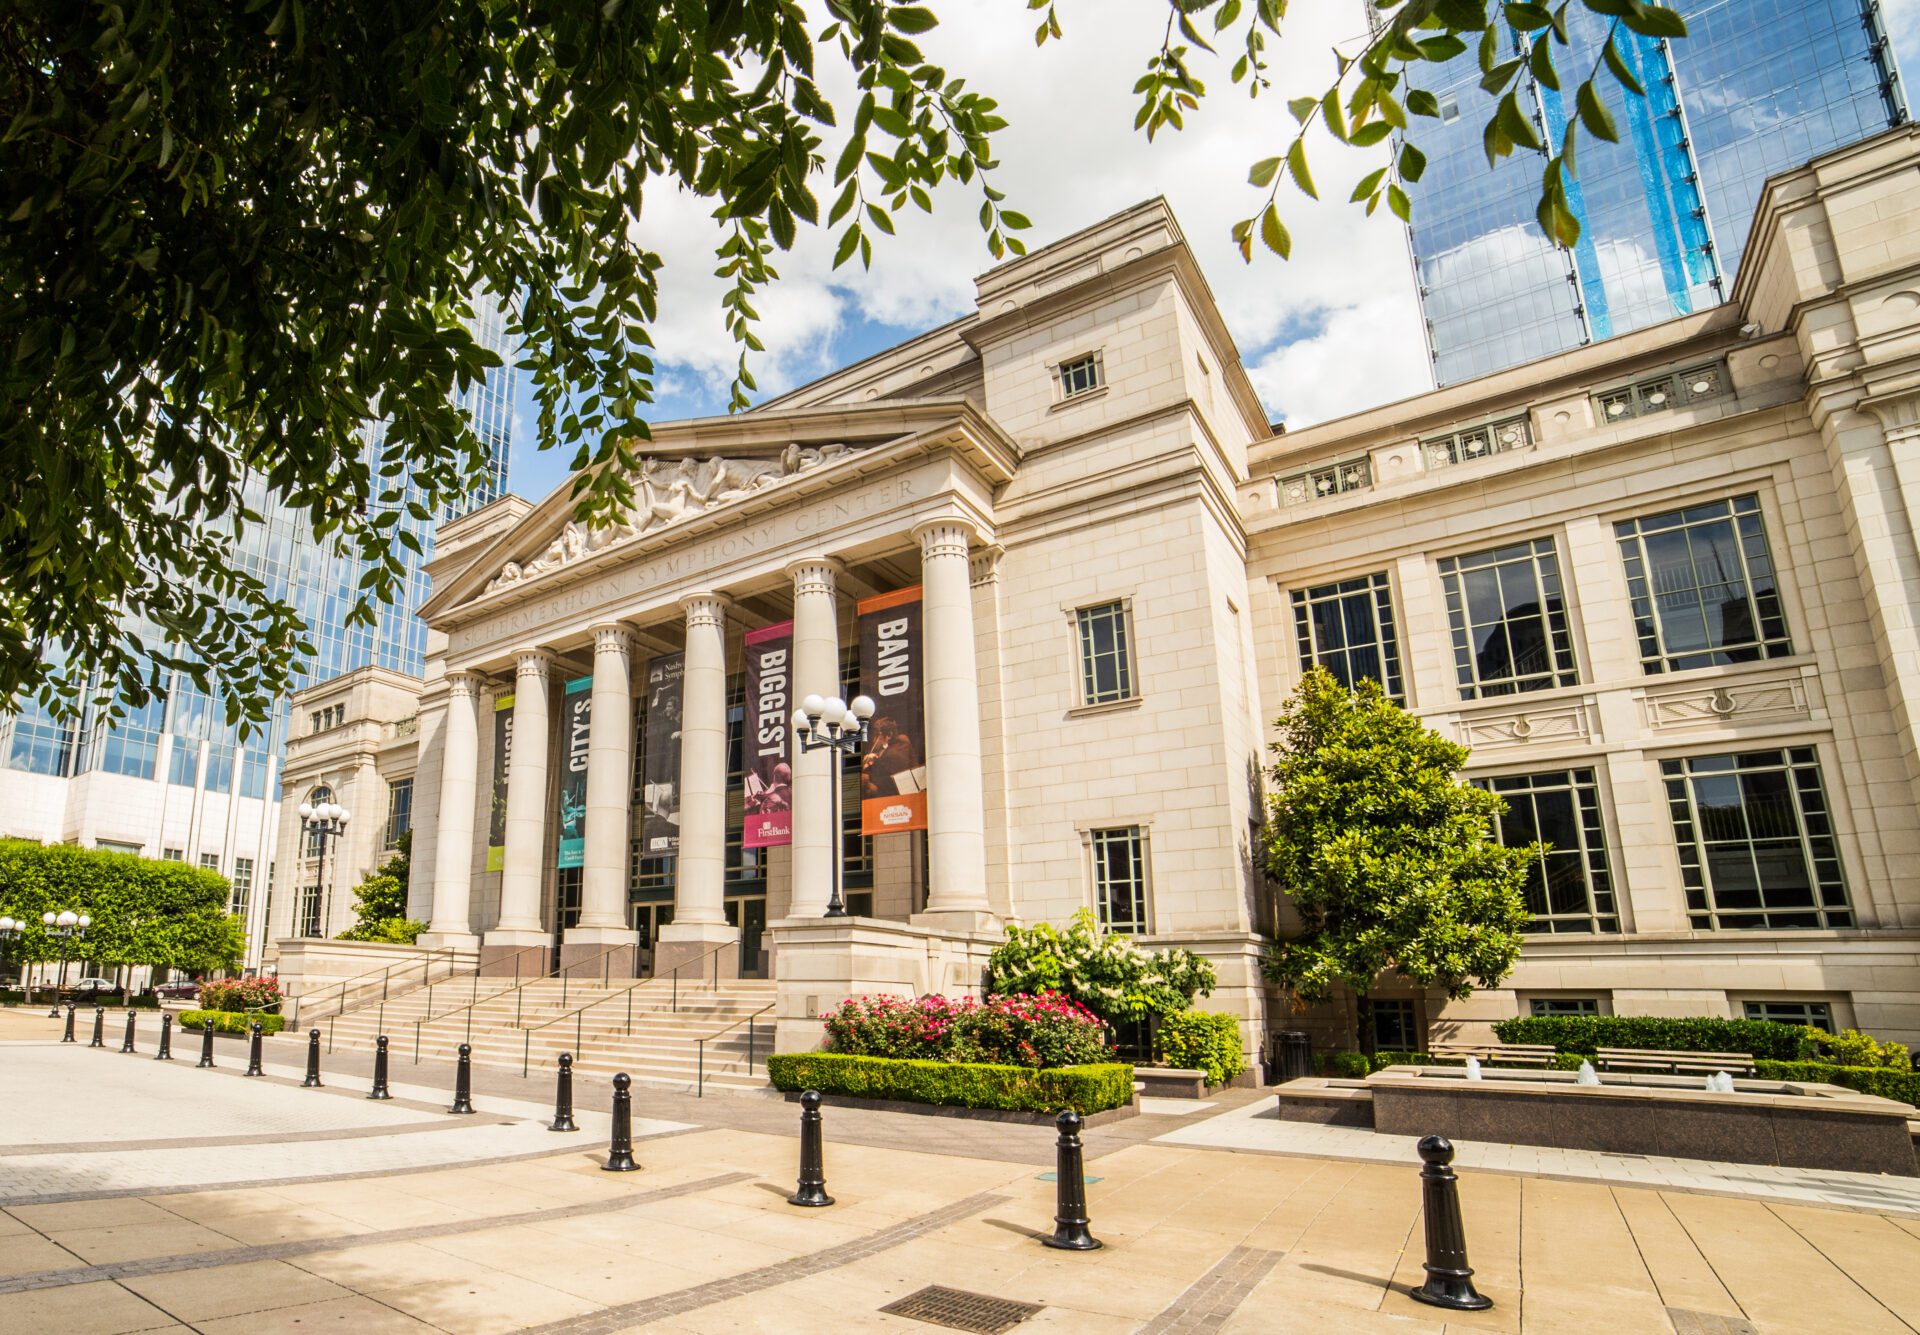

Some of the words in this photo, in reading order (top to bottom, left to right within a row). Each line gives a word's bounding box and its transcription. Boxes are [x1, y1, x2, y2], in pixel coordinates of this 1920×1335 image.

[464, 581, 621, 647] SCHERMERHORN
[637, 526, 773, 586] SYMPHONY
[795, 480, 917, 532] CENTER
[877, 617, 910, 697] BAND
[569, 698, 593, 773] CITY'S
[758, 649, 787, 758] BIGGEST
[757, 826, 791, 838] FirstBank
